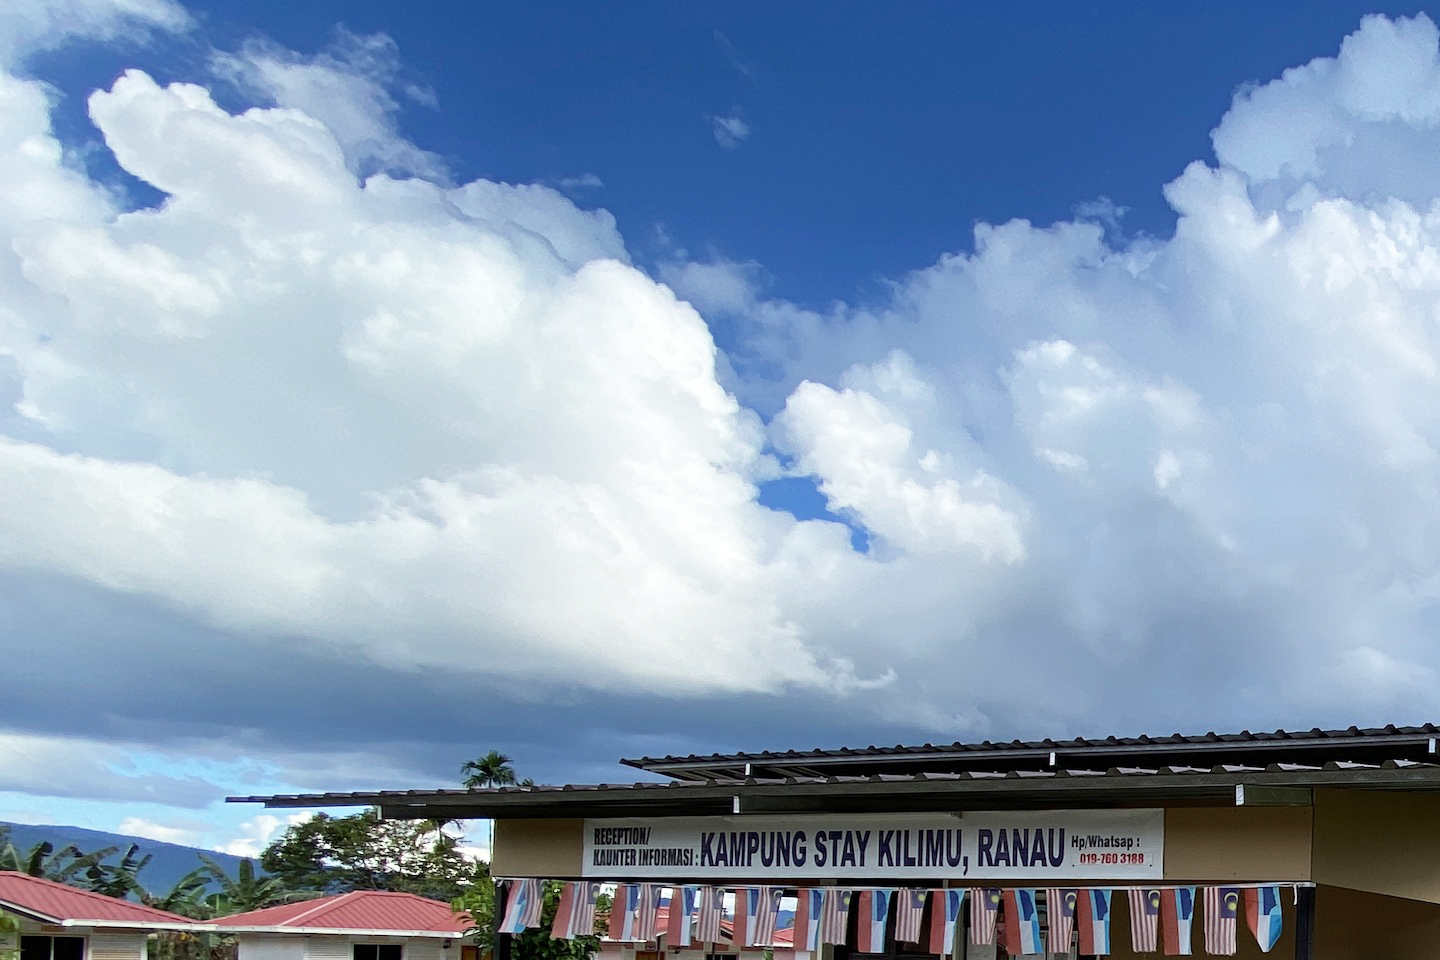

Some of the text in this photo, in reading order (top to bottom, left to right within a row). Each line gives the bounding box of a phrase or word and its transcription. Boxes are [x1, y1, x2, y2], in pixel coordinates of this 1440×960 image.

[594, 827, 651, 845] RECEPTION/
[593, 849, 637, 866] KAUNTER
[700, 828, 1065, 876] KAMPUNG STAY KILIMU, RANAU
[1080, 853, 1144, 864] 019-760 3188
